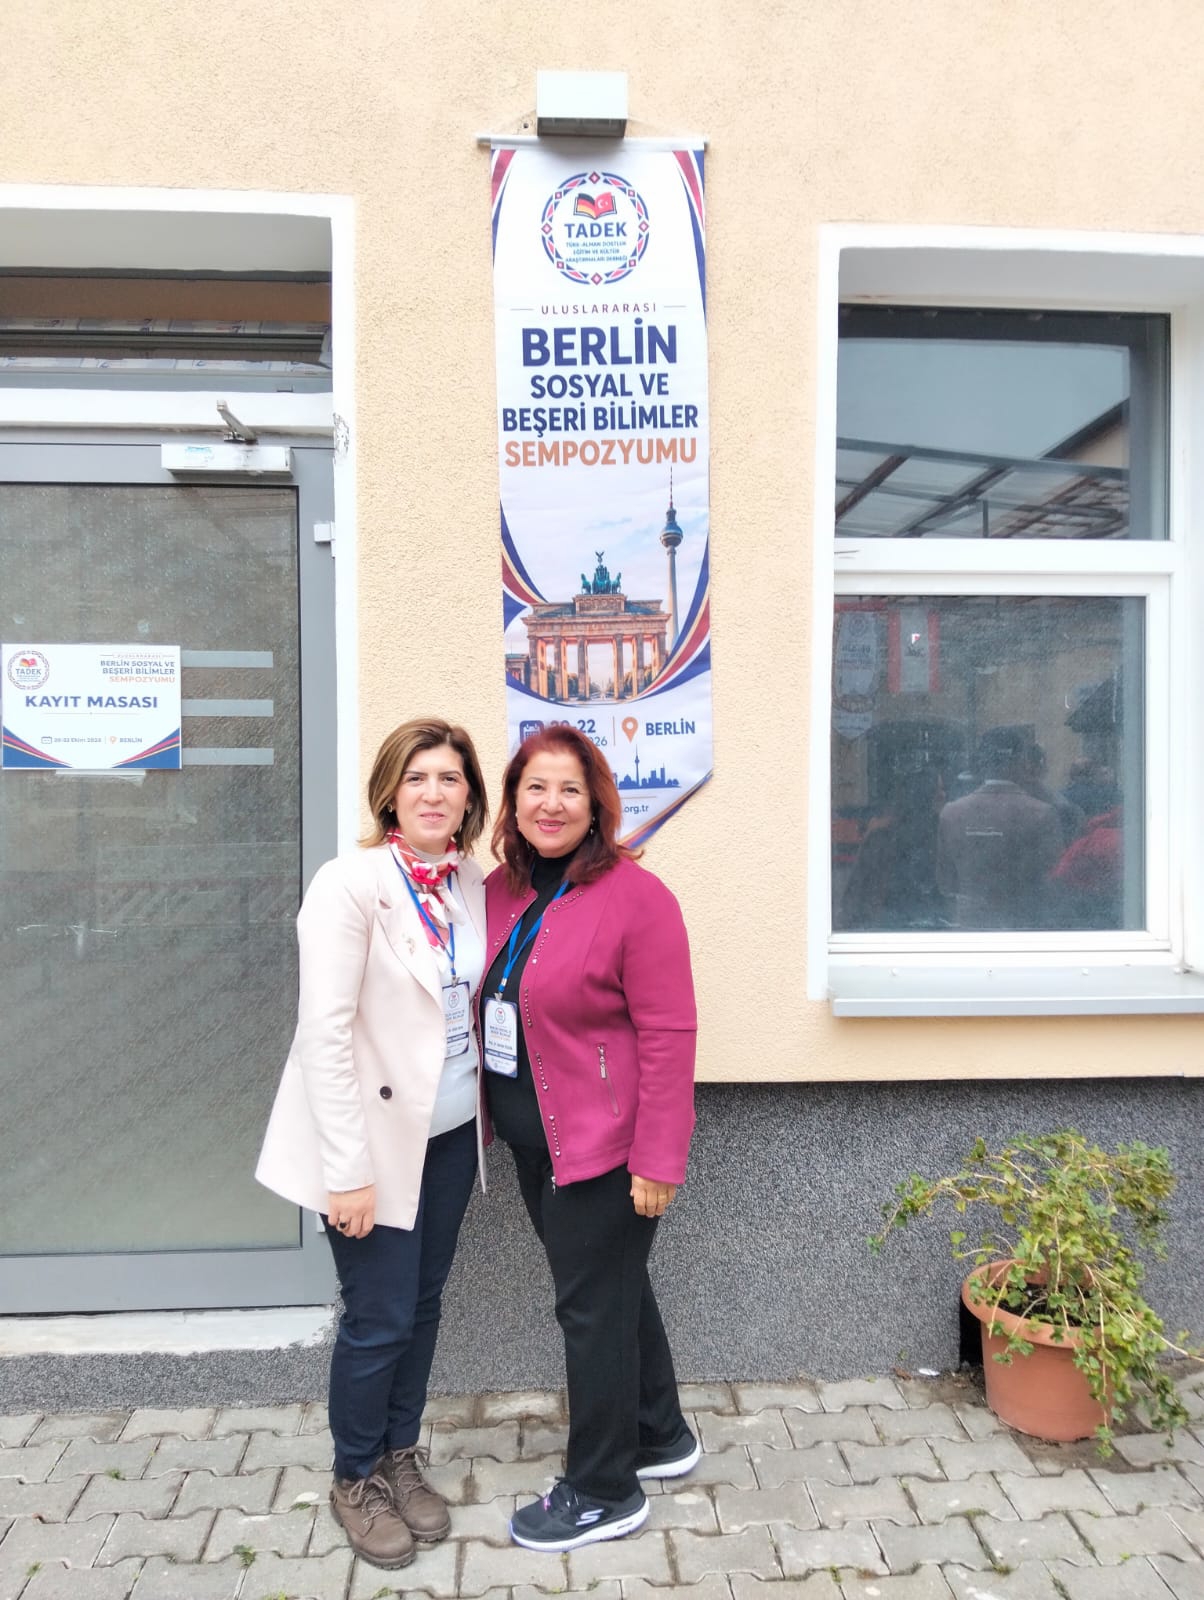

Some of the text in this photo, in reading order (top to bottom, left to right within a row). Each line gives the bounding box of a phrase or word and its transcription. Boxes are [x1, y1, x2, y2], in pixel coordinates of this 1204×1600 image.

[564, 222, 627, 238] TADEK
[541, 303, 656, 315] ULUSLARARASI
[522, 317, 677, 367] BERLİN
[530, 373, 669, 399] SOSYAL VE
[502, 400, 699, 438] BEŞERİ BİLİMLER
[505, 437, 697, 468] SEMPOZYUMU
[25, 696, 158, 708] KAYIT MASASI
[645, 718, 696, 736] BERLİN
